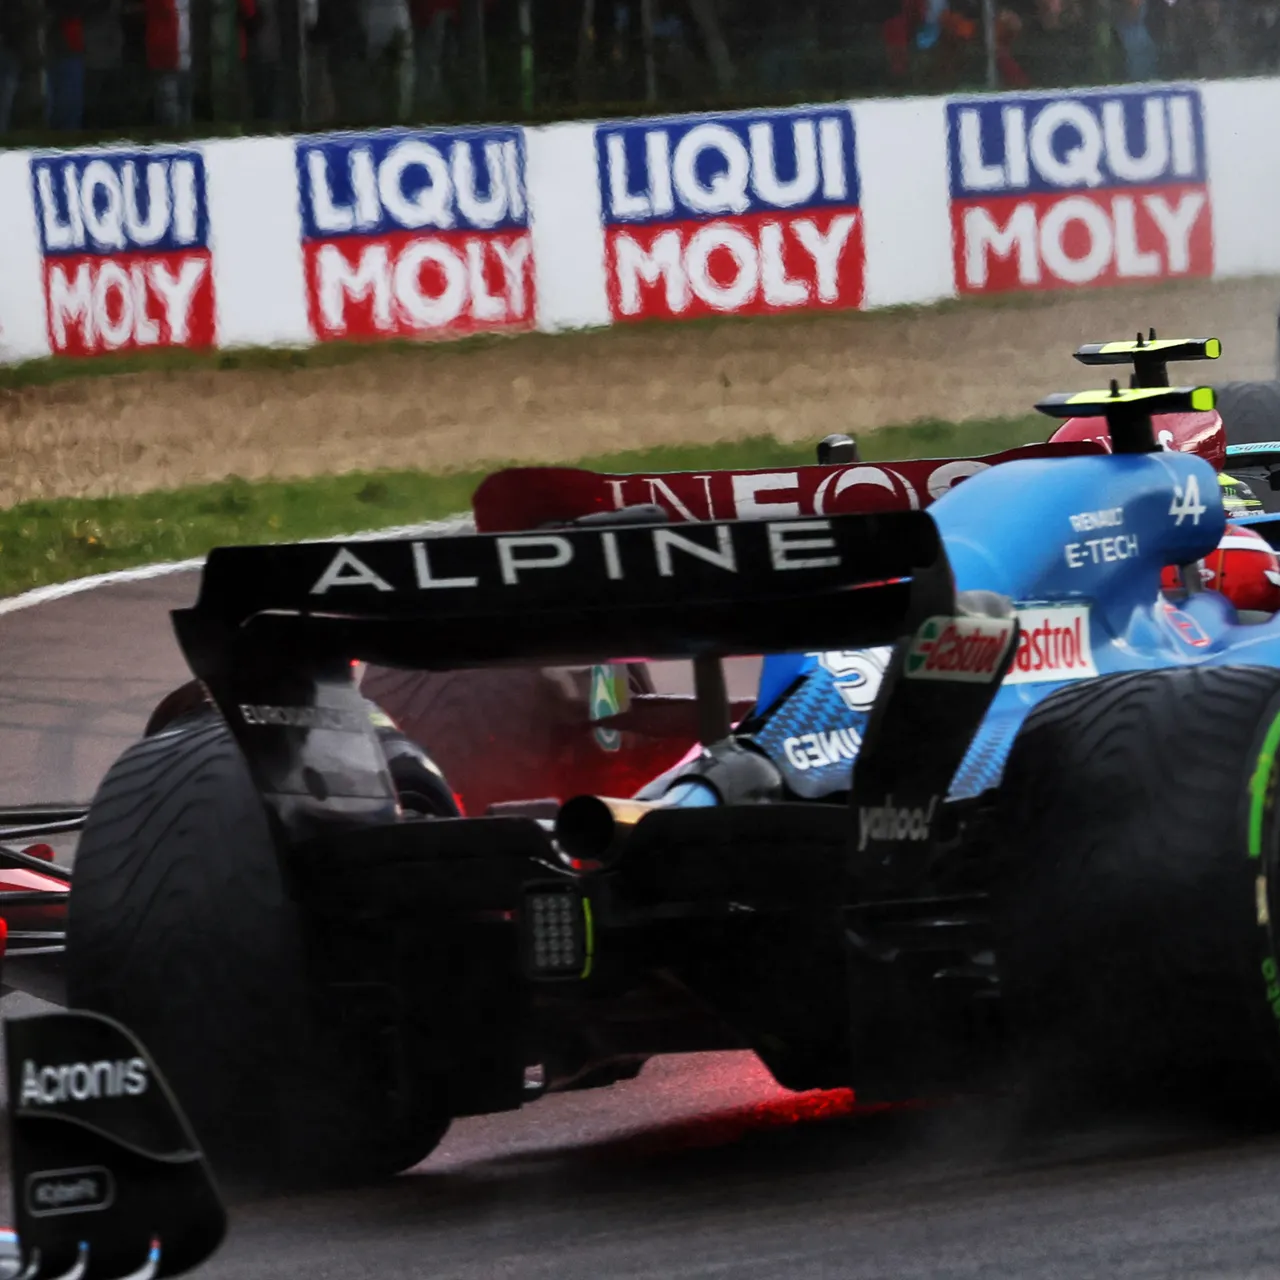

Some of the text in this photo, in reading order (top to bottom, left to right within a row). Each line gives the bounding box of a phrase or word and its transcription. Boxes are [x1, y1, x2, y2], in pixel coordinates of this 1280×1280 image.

[309, 140, 525, 231] LIQUI
[608, 118, 846, 217] LIQUI
[961, 97, 1195, 190] LIQUI
[38, 159, 197, 249] LIQUI
[965, 191, 1204, 287] MOLY
[50, 258, 207, 349] MOLY
[317, 233, 533, 327] MOLY
[612, 214, 854, 314] MOLY
[310, 521, 841, 594] ALPINE
[1065, 534, 1139, 568] E-TECH
[925, 622, 1008, 673] Castrol
[1007, 616, 1087, 675] astrol
[20, 1058, 148, 1104] Acronis
